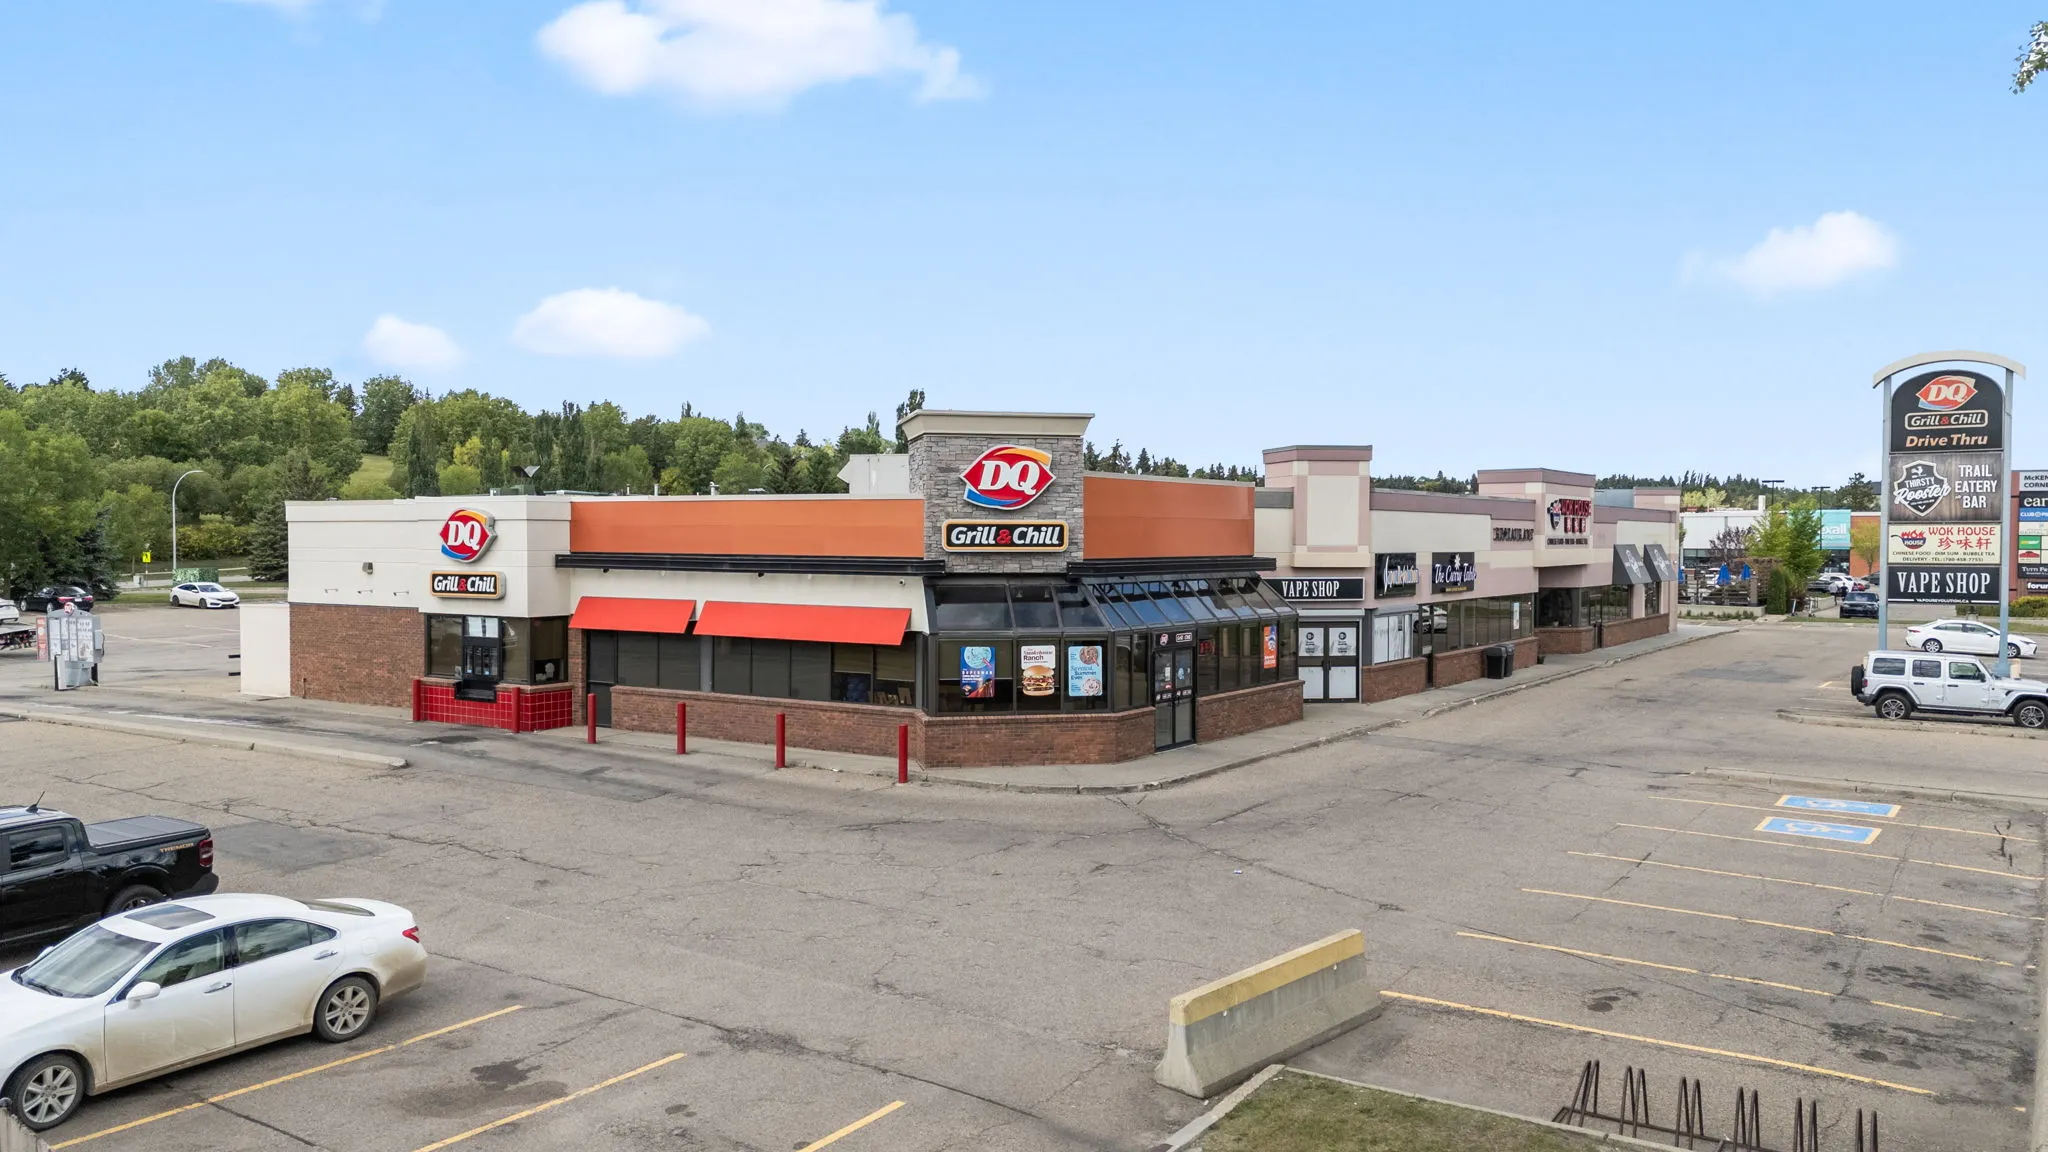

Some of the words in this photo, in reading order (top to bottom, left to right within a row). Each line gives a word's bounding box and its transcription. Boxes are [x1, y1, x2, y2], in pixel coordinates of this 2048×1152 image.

[1927, 383, 1968, 402] DQ
[1905, 435, 1948, 447] Drive
[1951, 433, 1988, 446] Thru
[978, 460, 1041, 495] DQ
[1958, 464, 1992, 477] TRAIL
[1904, 477, 1935, 489] THIRSTY
[1955, 480, 1997, 493] EATERY
[1893, 484, 1952, 505] Rooster
[1963, 495, 1987, 508] BAR
[447, 520, 481, 551] DQ
[1818, 523, 1847, 535] exall
[1928, 527, 1954, 536] WOK
[1957, 527, 1996, 536] HOUSE
[1937, 536, 1992, 550] 珍味轩
[1434, 563, 1444, 584] The
[1445, 564, 1463, 586] Curry
[1282, 580, 1309, 597] VAPE
[1312, 581, 1340, 597] SHOP
[1896, 571, 1940, 593] VAPE
[1946, 572, 1990, 594] SHOP
